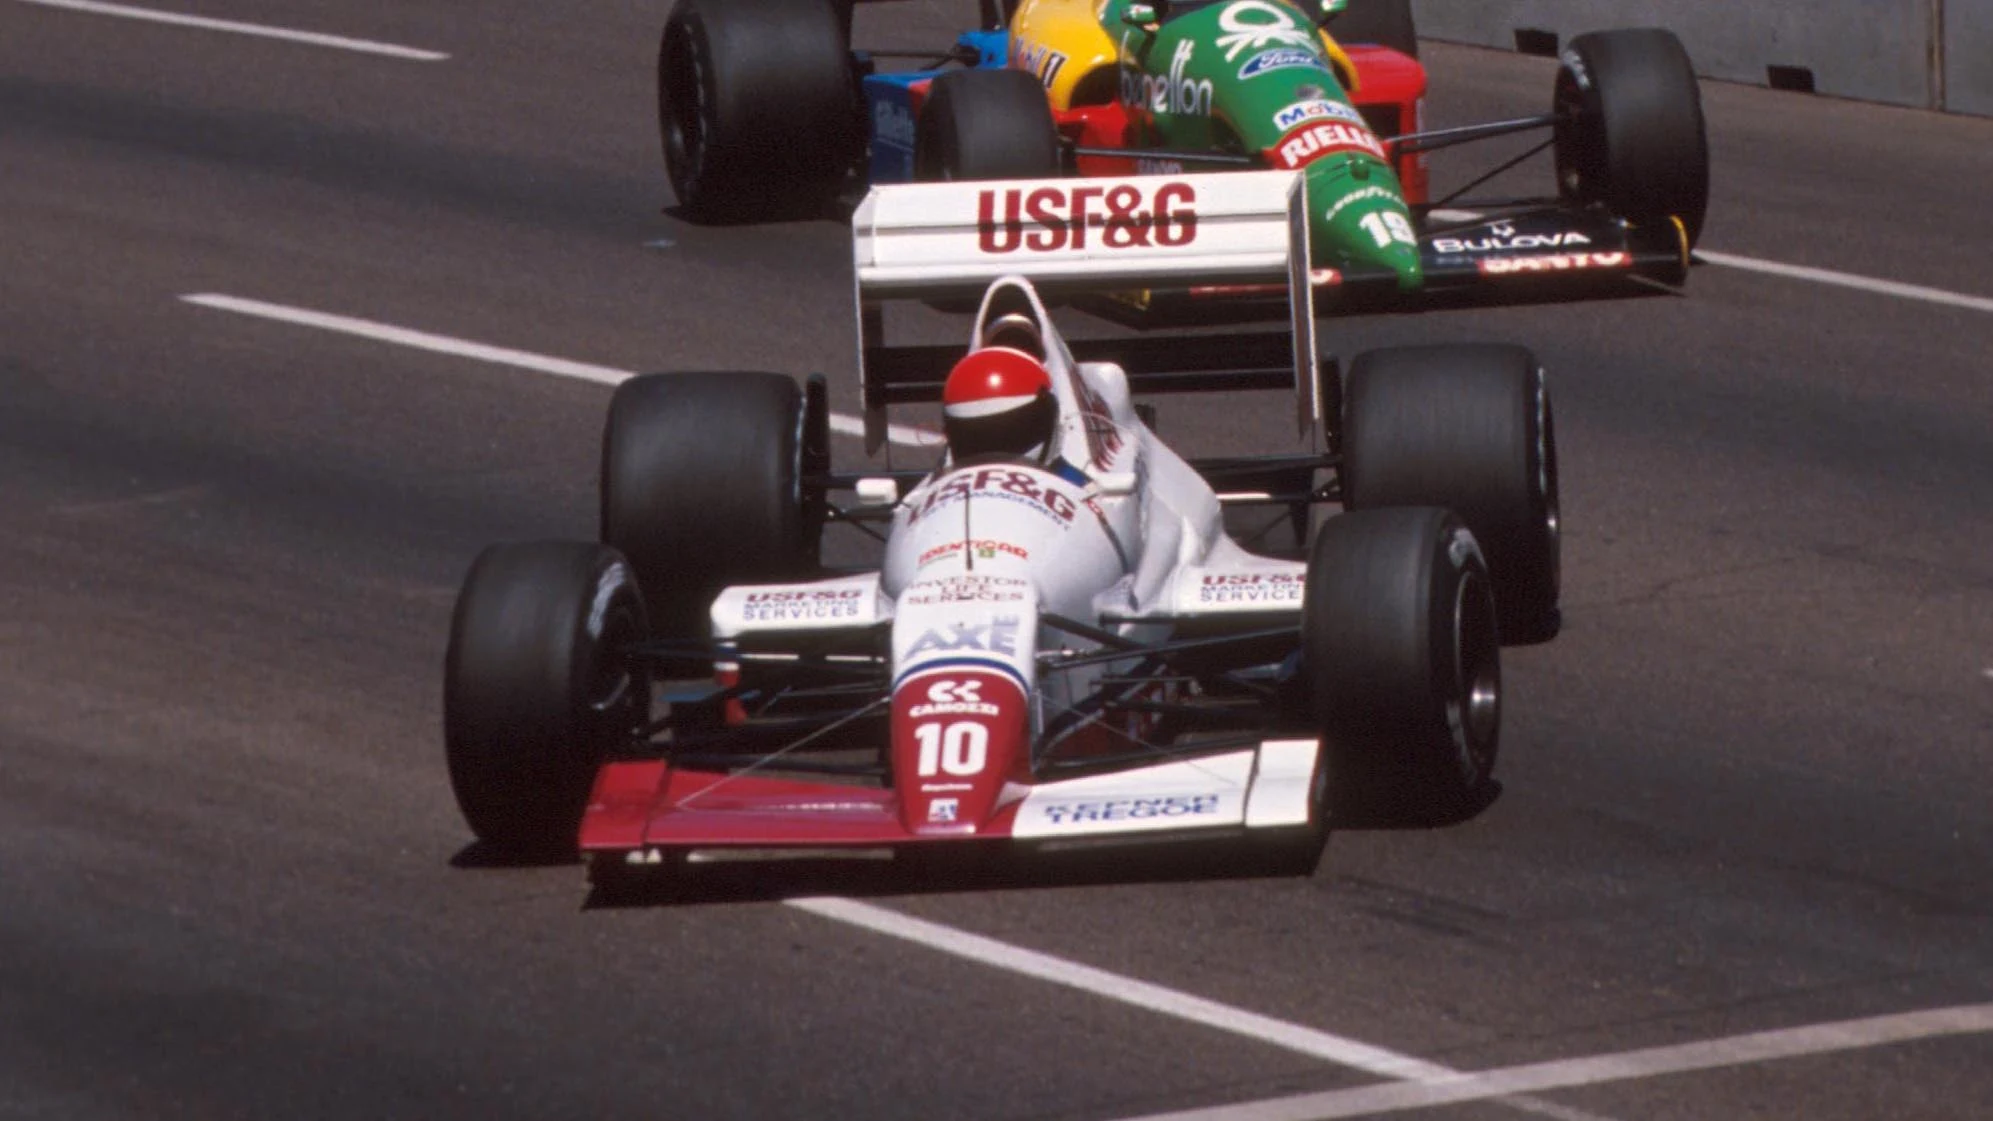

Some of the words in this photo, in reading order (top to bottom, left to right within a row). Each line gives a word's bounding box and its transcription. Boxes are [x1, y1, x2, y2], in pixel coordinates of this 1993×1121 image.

[977, 181, 1197, 254] USF&G
[1358, 210, 1418, 249] 19
[1432, 231, 1592, 254] BULOVA
[906, 468, 1078, 527] USF&G
[743, 606, 860, 620] SERVICES
[746, 588, 862, 603] USF&G
[903, 614, 1020, 661] AXE
[914, 721, 990, 778] 10
